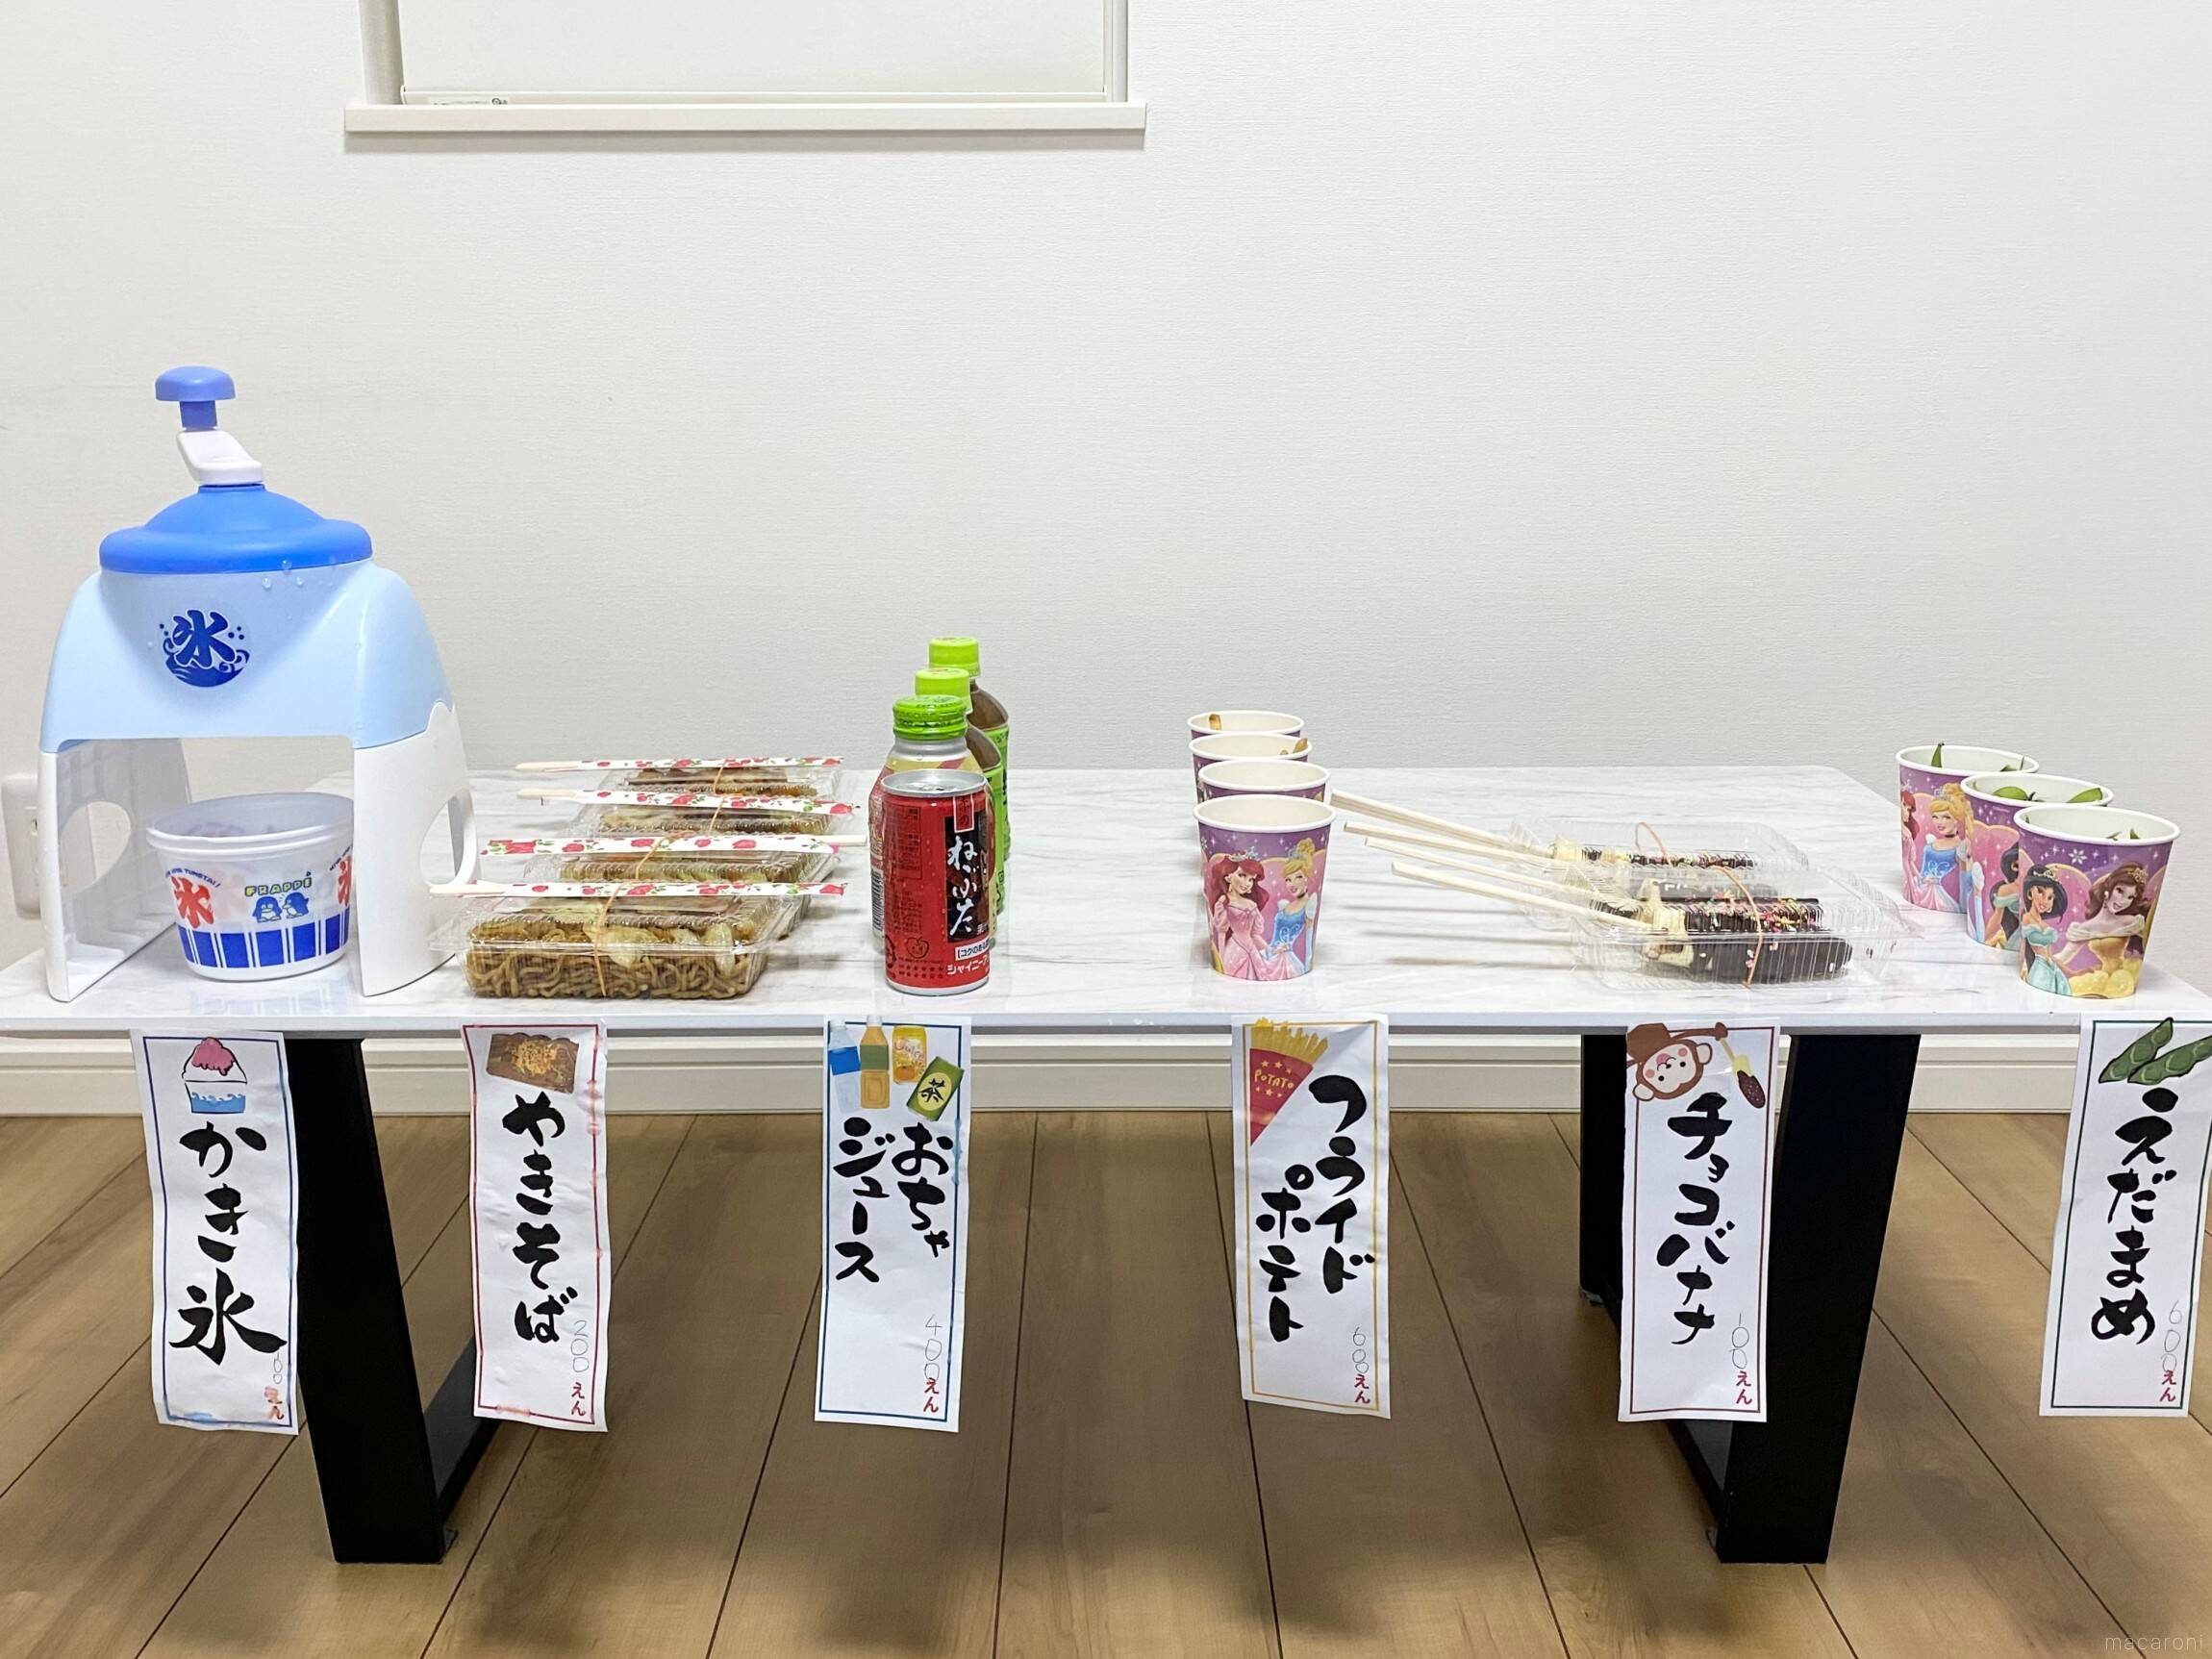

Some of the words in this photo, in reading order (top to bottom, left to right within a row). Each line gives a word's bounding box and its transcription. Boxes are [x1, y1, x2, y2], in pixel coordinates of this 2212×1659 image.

[171, 608, 237, 669] 氷
[171, 875, 214, 930] 氷
[946, 835, 980, 937] ねぶた
[917, 1077, 944, 1103] 茶
[169, 1121, 287, 1366] かき氷
[502, 1092, 578, 1344] やきそば
[833, 1117, 895, 1283] ジュース
[892, 1121, 954, 1258] おちゃ
[1256, 1164, 1315, 1343] ポテト
[1308, 1074, 1375, 1295] フライド
[1656, 1092, 1735, 1345] チョコバナナ
[2090, 1087, 2177, 1345] えだまめ
